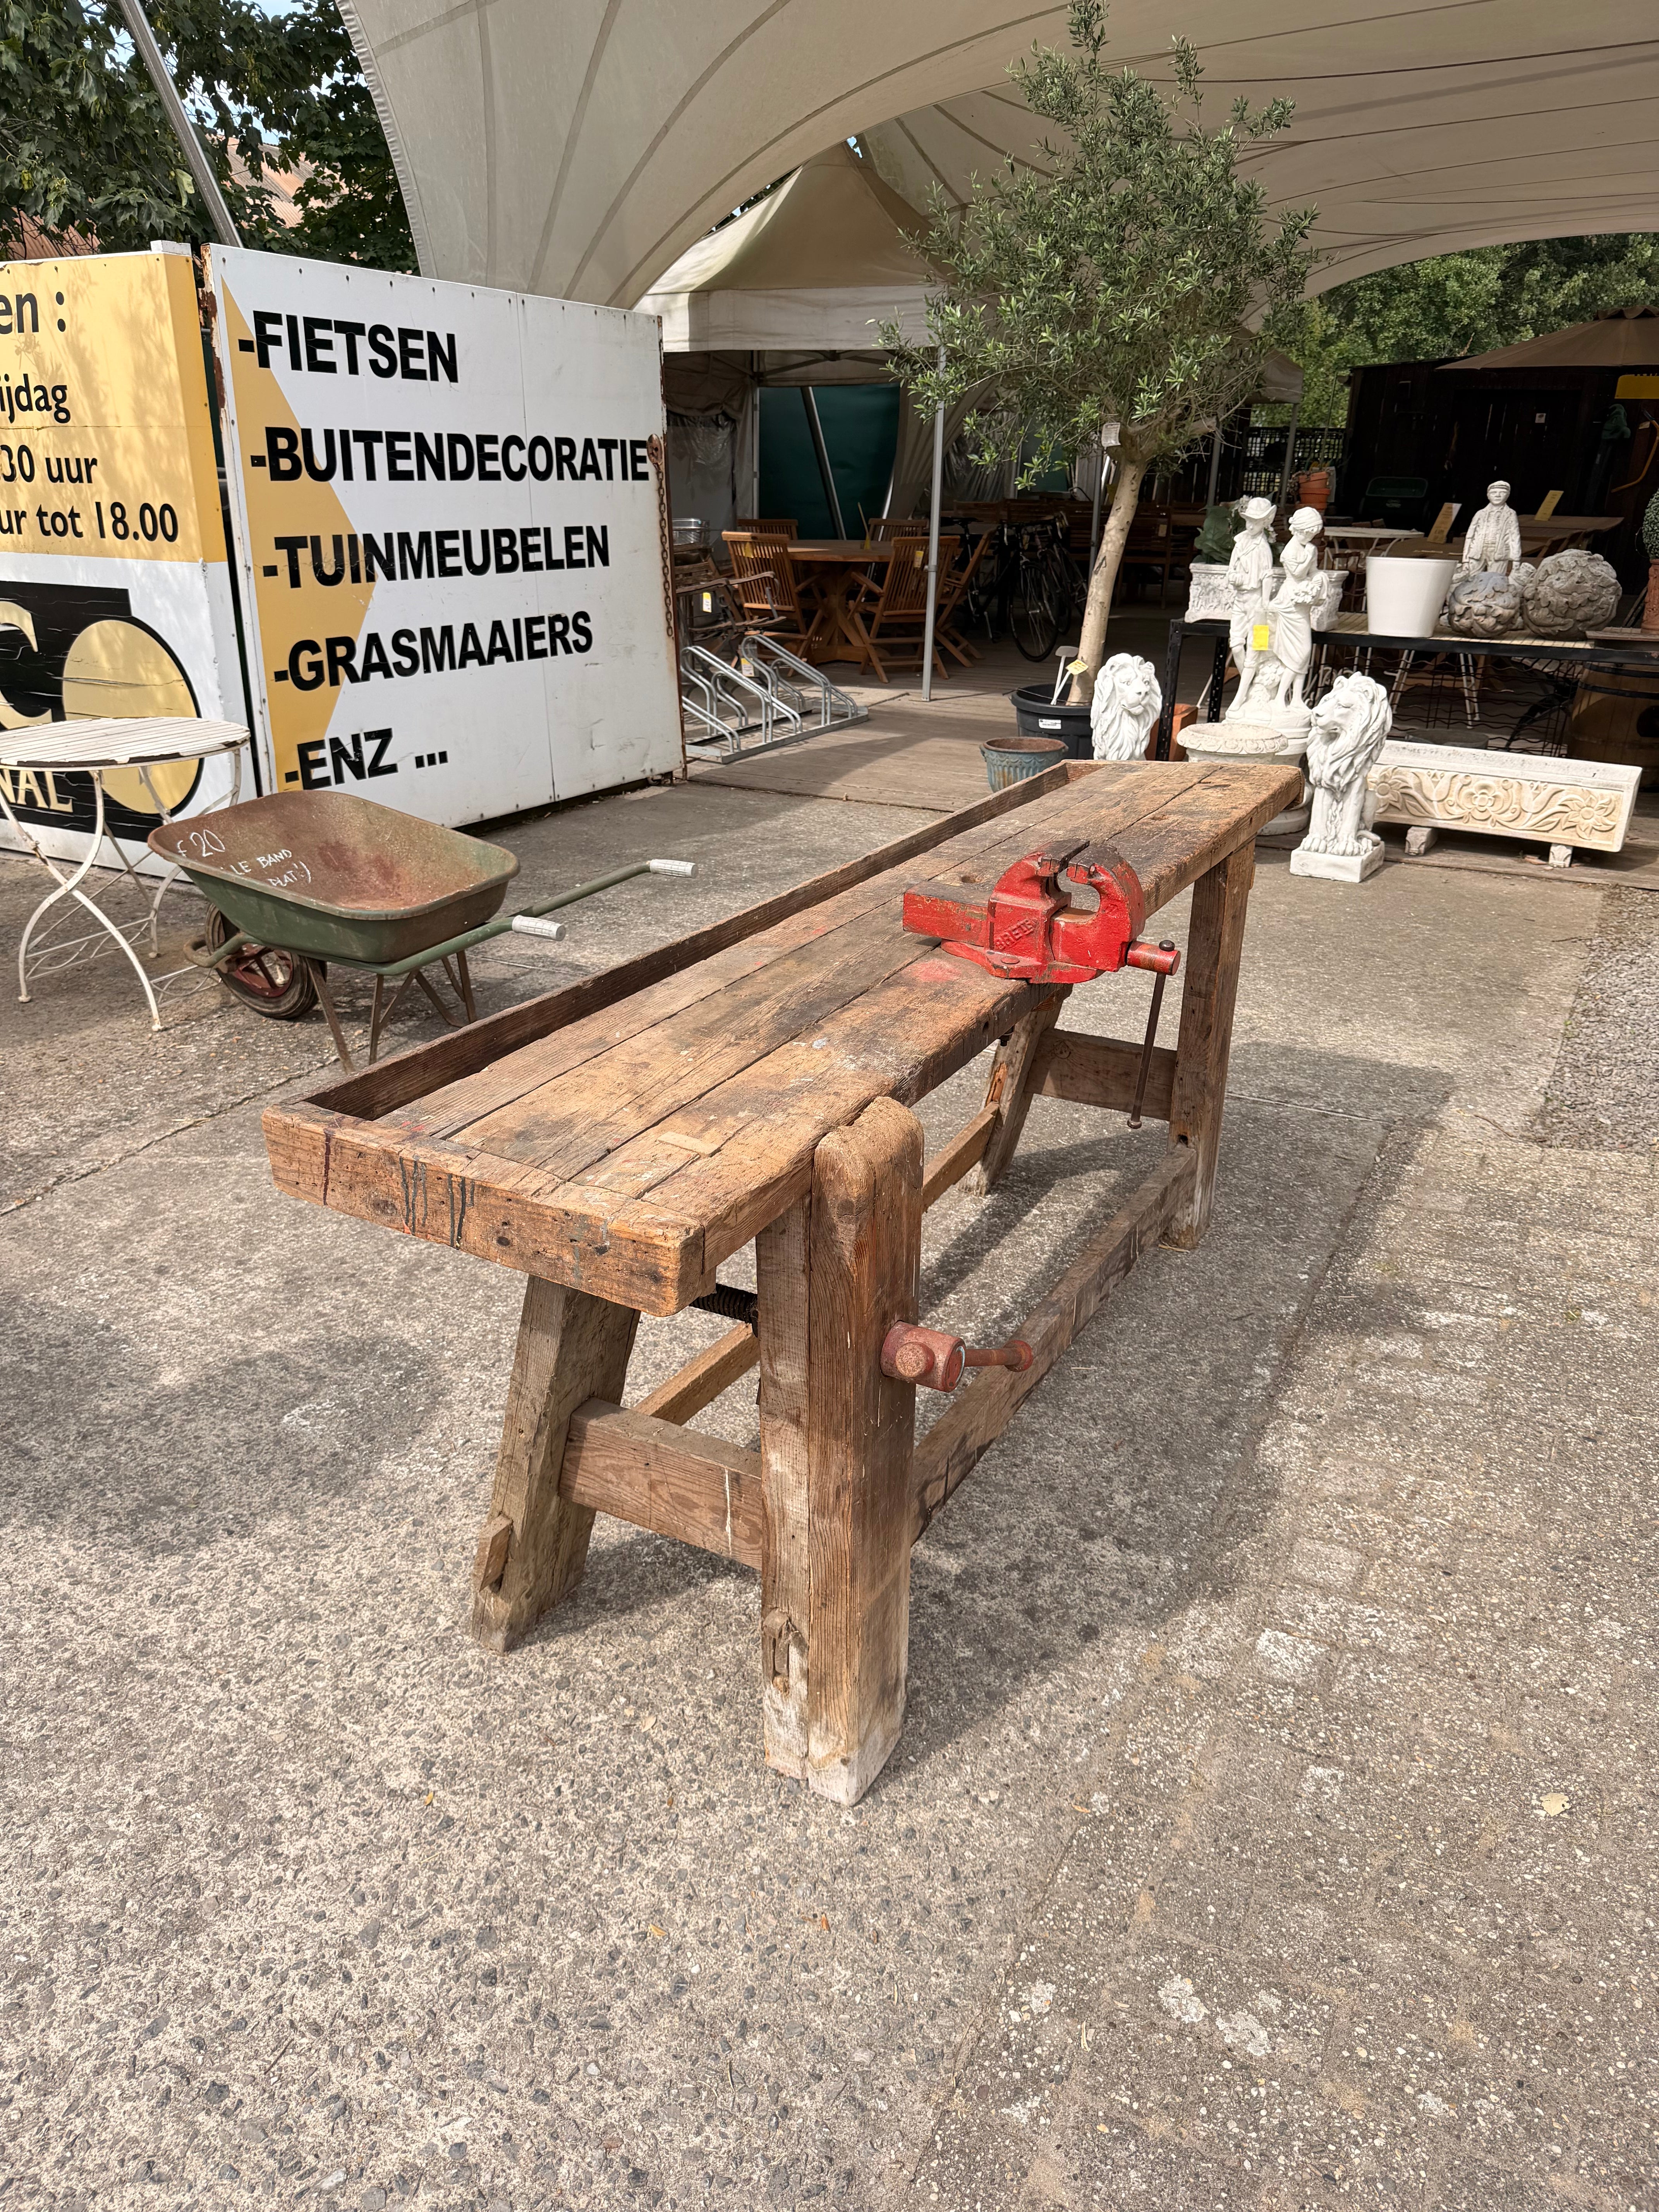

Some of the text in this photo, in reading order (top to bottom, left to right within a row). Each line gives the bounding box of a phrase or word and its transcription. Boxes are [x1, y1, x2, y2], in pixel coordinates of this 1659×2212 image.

[45, 457, 98, 484] uur
[36, 504, 83, 538] tot
[95, 501, 178, 542] 18.00
[256, 848, 292, 869] BAND
